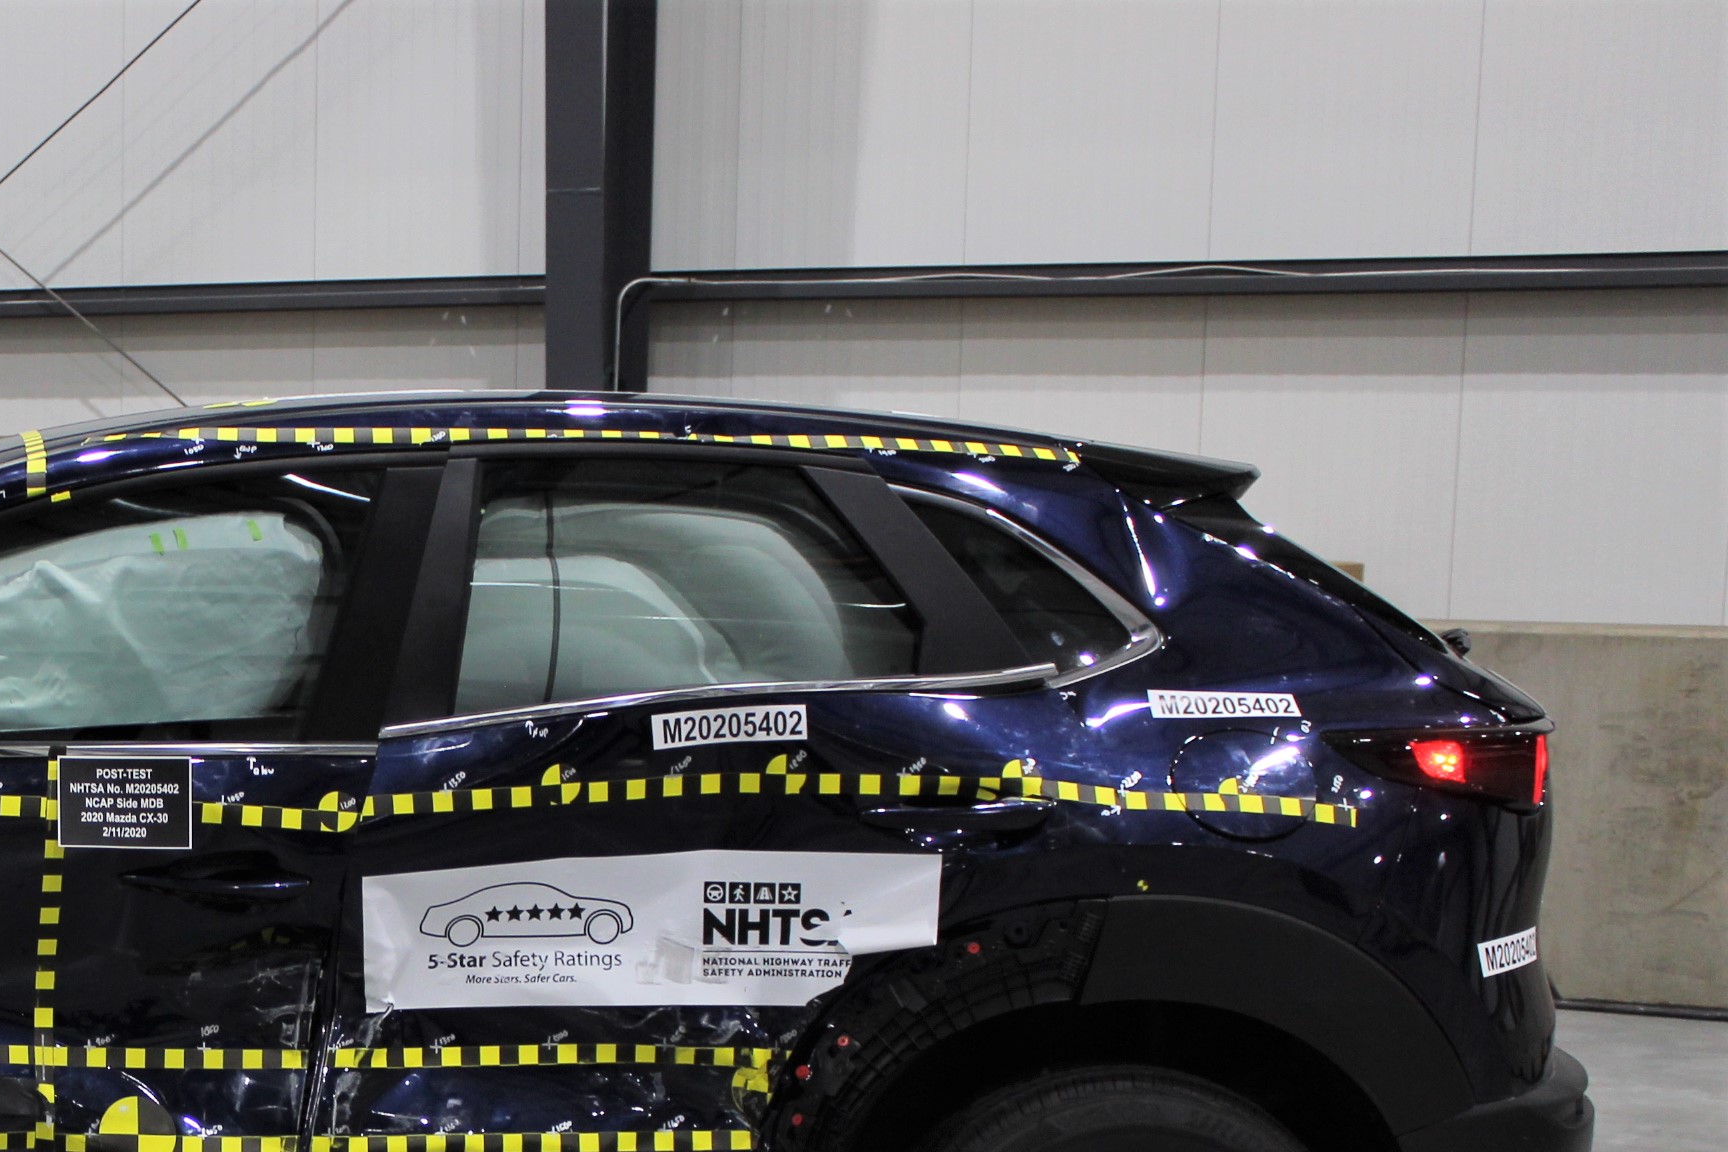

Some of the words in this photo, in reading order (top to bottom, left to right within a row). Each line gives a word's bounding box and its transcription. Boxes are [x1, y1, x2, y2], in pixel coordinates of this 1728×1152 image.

[1157, 694, 1295, 716] M20205402
[663, 710, 803, 744] M20205402
[96, 768, 152, 780] POST-TEST
[69, 783, 105, 794] NHTSA
[107, 783, 123, 794] No.
[125, 783, 179, 794] M20205402
[85, 798, 114, 809] NCAP
[116, 797, 138, 809] Side
[140, 798, 164, 809] MDB
[81, 812, 104, 823] 2020
[105, 812, 137, 824] Mazda
[139, 813, 169, 824] CX-30
[102, 826, 147, 838] 2/11/2020
[703, 907, 852, 947] NHTS
[427, 953, 487, 969] 5-Star
[492, 951, 549, 971] Safety
[554, 950, 622, 970] Ratings
[703, 957, 759, 967] NATIONAL
[763, 958, 813, 967] HIGHWAY
[465, 974, 492, 984] More
[524, 973, 550, 984] Safer
[552, 973, 577, 983] Cars.
[703, 968, 744, 977] SAFETY
[747, 968, 843, 978] ADMINISTRATION
